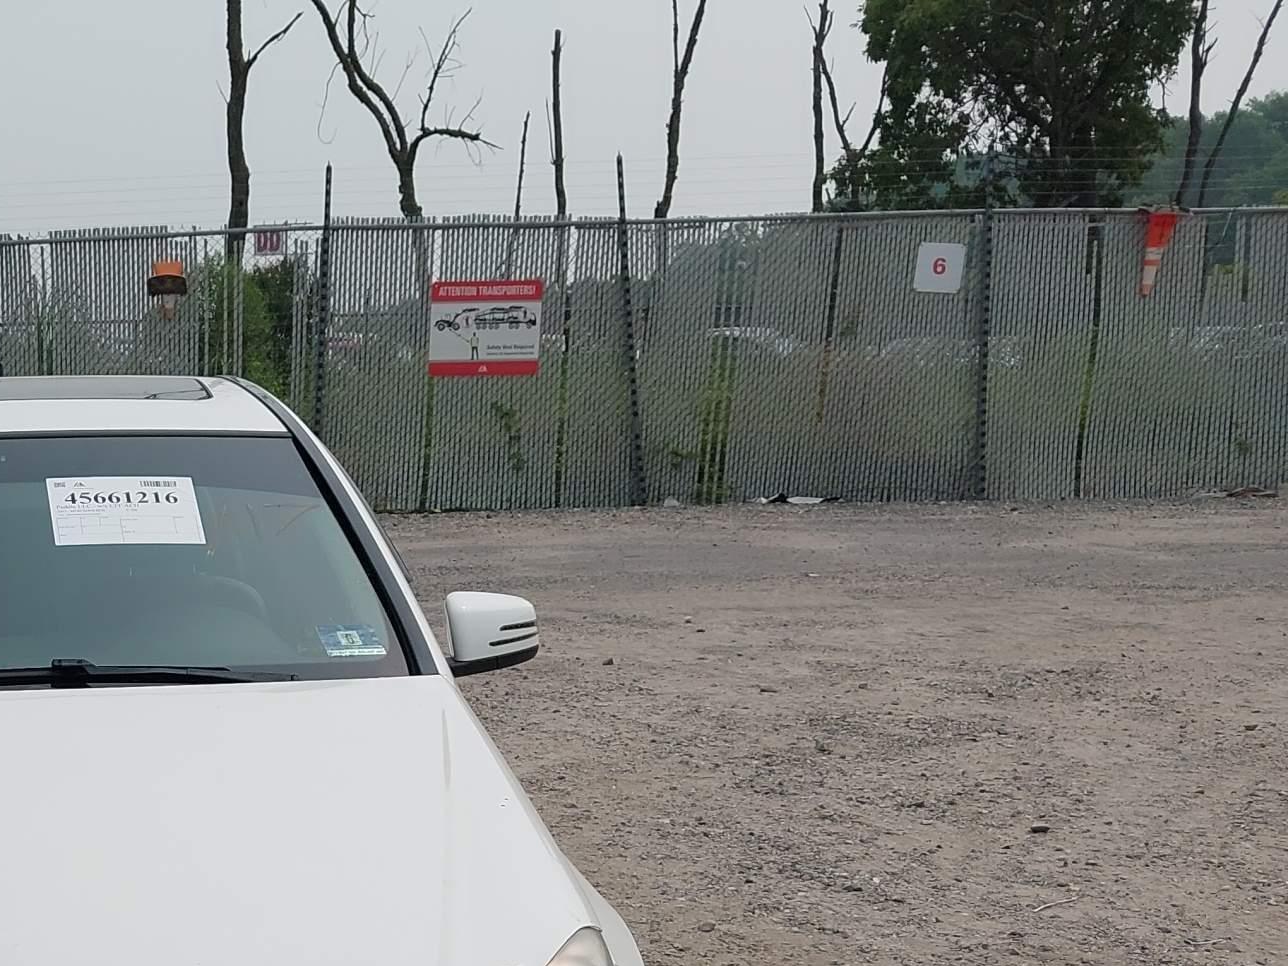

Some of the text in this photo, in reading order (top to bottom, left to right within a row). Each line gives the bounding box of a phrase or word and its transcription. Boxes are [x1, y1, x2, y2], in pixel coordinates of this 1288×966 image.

[933, 257, 947, 275] 6
[439, 285, 536, 297] ATTENTION TRANSPORTERS!
[64, 491, 179, 505] 45661216
